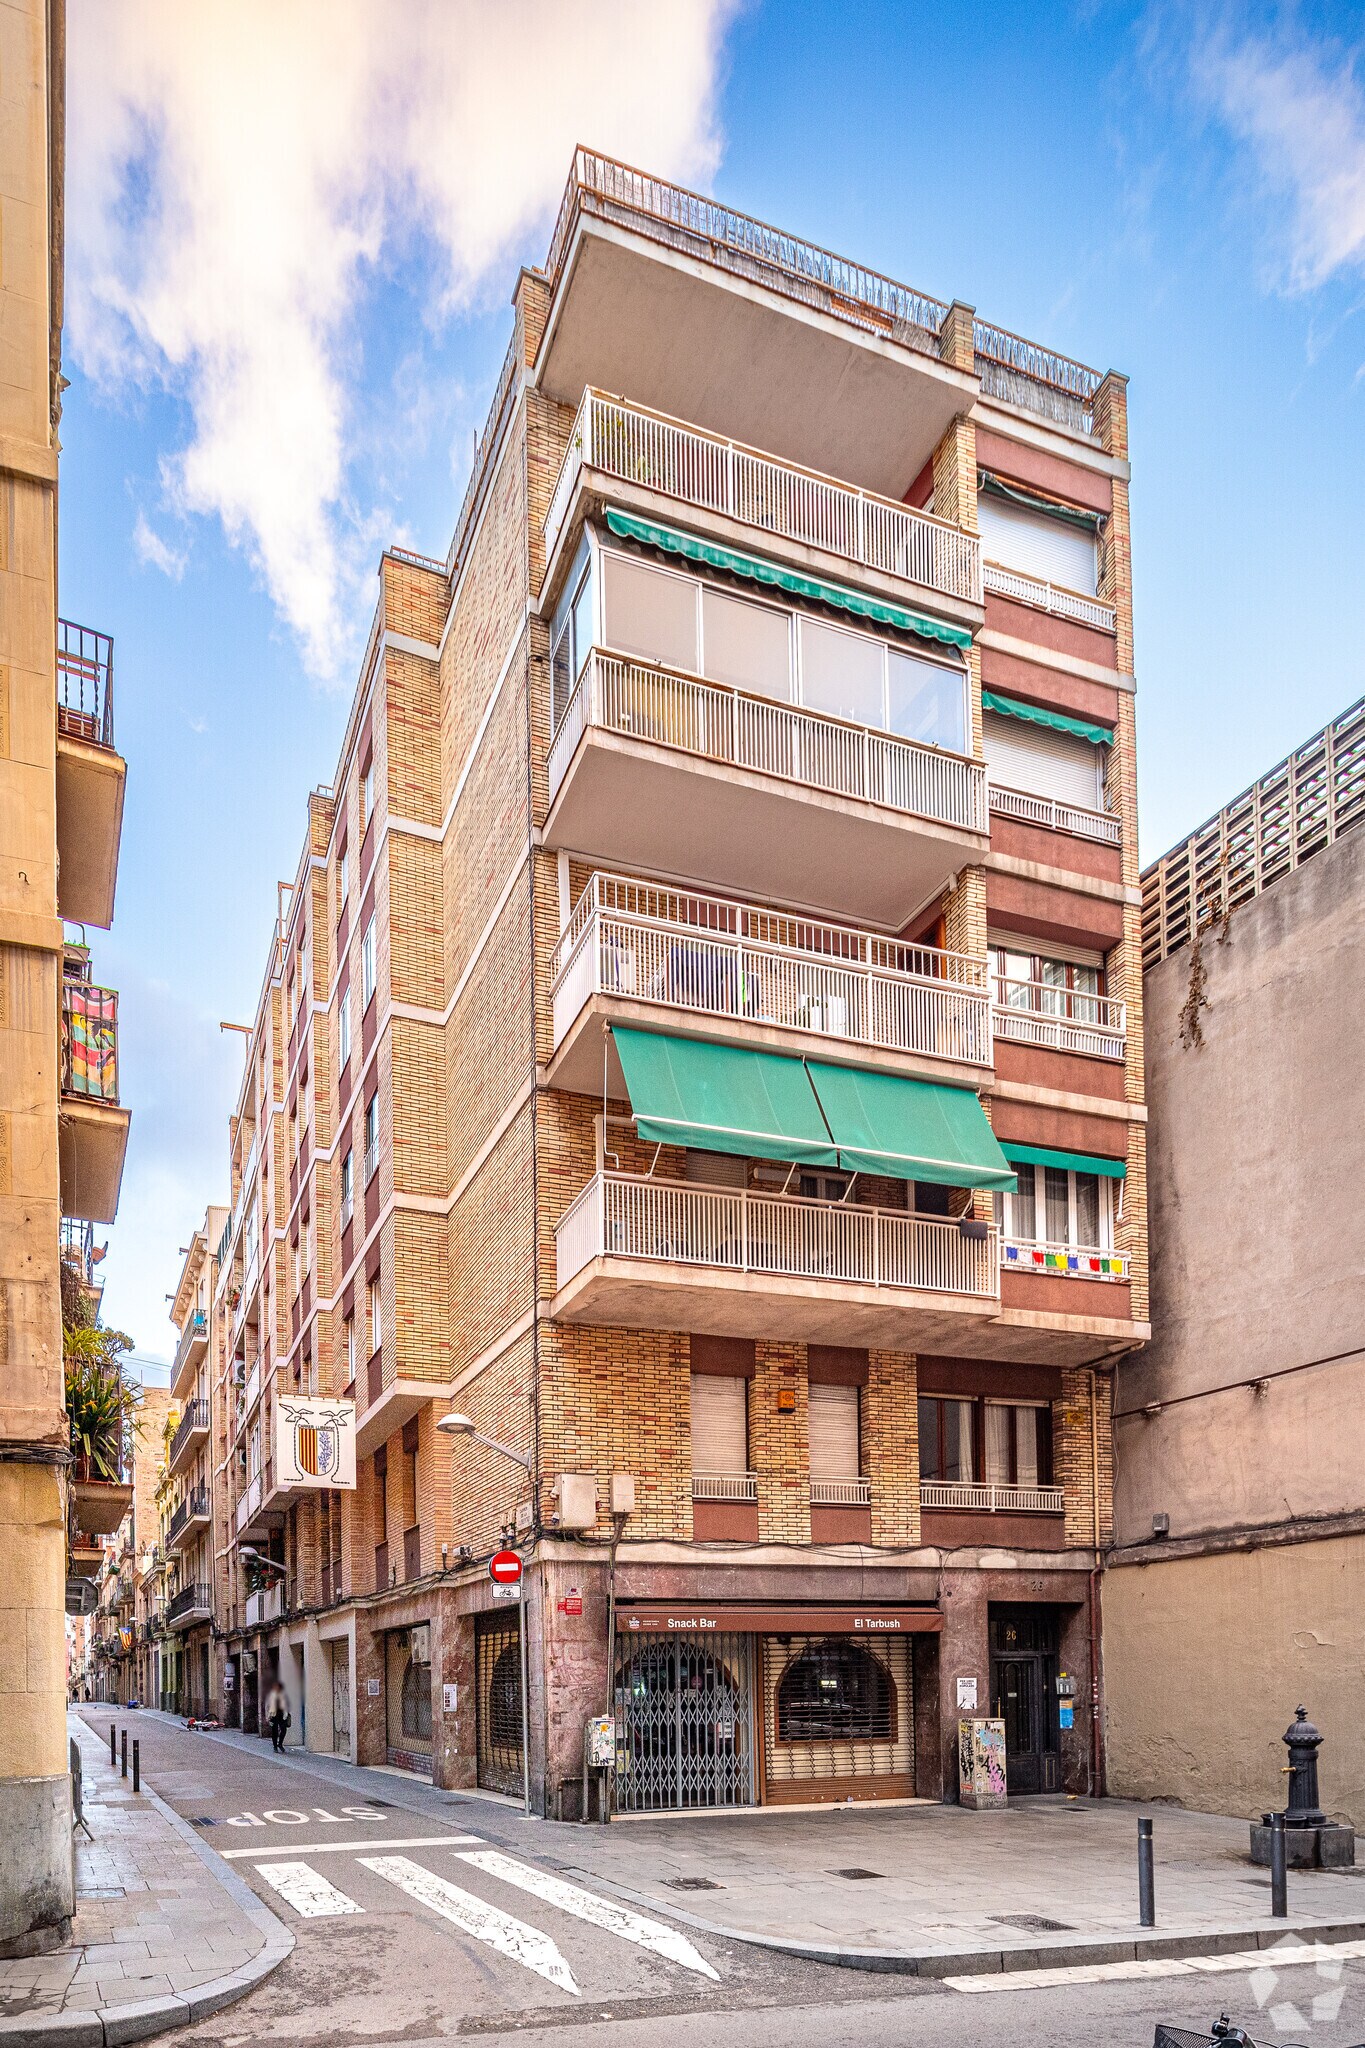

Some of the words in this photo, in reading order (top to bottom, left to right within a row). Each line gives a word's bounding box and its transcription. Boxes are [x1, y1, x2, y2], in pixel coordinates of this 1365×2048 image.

[1031, 1581, 1043, 1592] 26
[667, 1618, 698, 1628] Snack
[699, 1618, 717, 1628] Bar
[854, 1619, 863, 1628] El
[865, 1619, 901, 1628] Tarbush
[1006, 1630, 1017, 1641] 26
[226, 1806, 388, 1827] STOP
